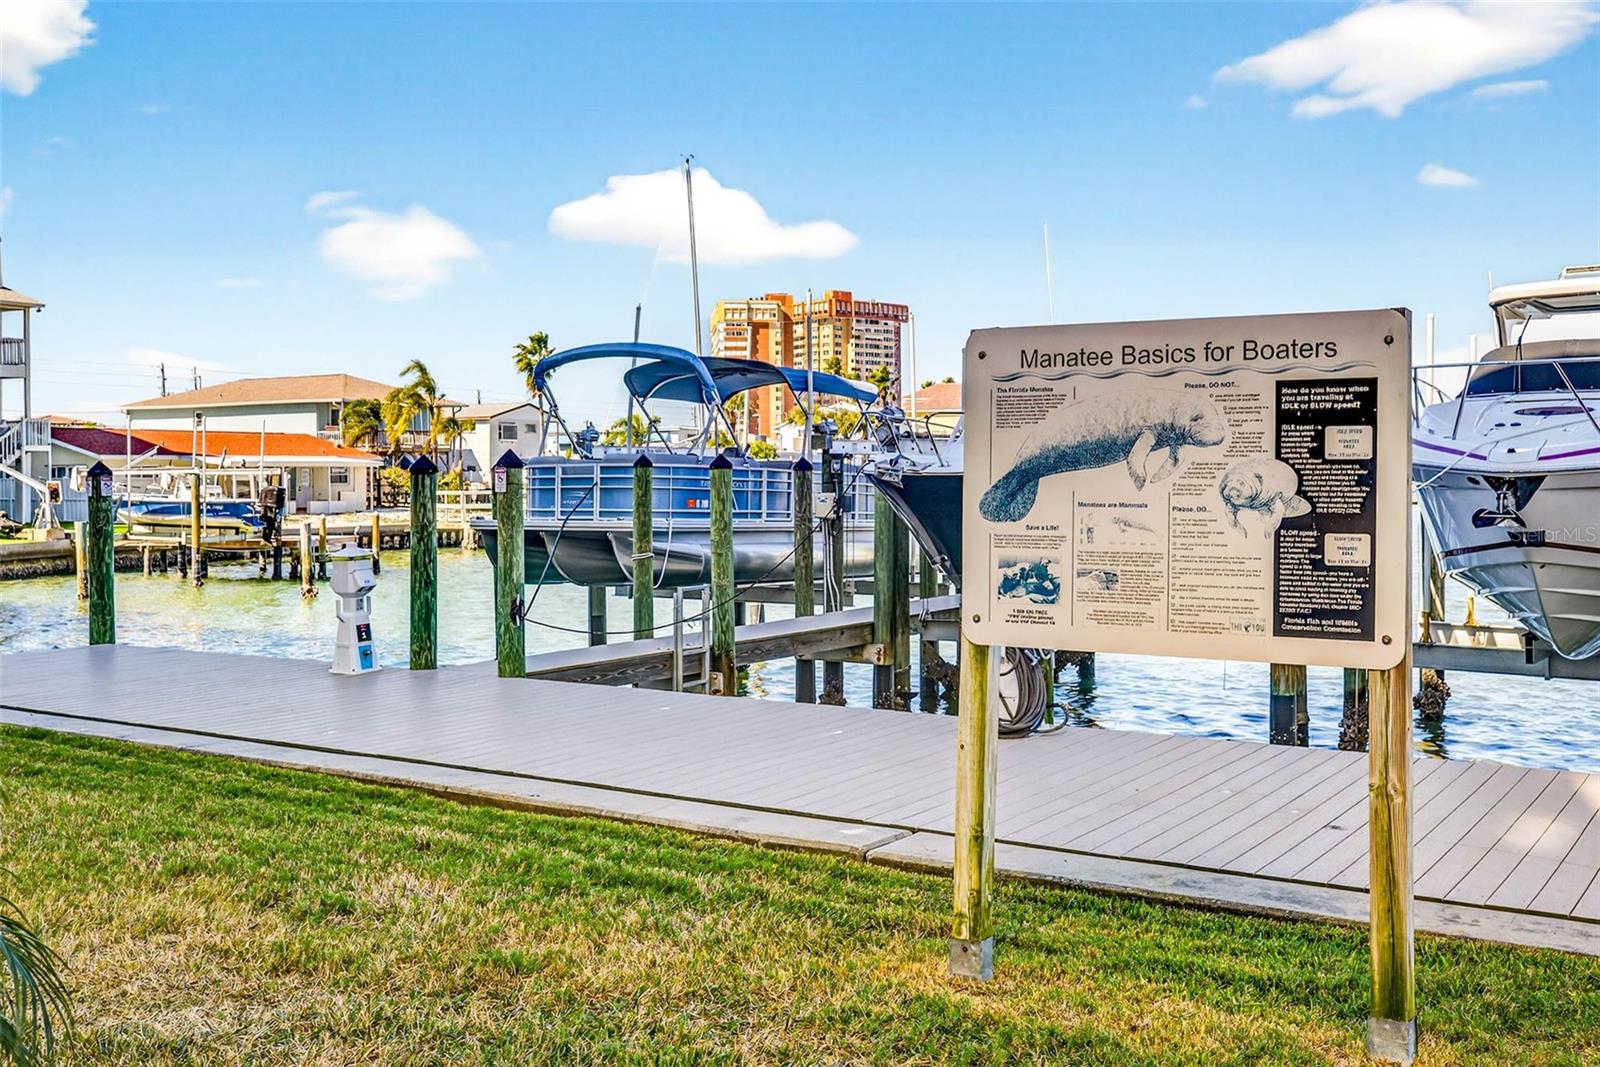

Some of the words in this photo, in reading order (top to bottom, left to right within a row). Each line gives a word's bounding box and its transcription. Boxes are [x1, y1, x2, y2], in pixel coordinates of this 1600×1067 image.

[1020, 348, 1113, 369] Manatee
[1121, 344, 1196, 365] Basics
[1203, 341, 1235, 362] for
[1242, 338, 1338, 361] Boaters
[1333, 401, 1361, 409] speed?
[1323, 625, 1361, 633] Commission
